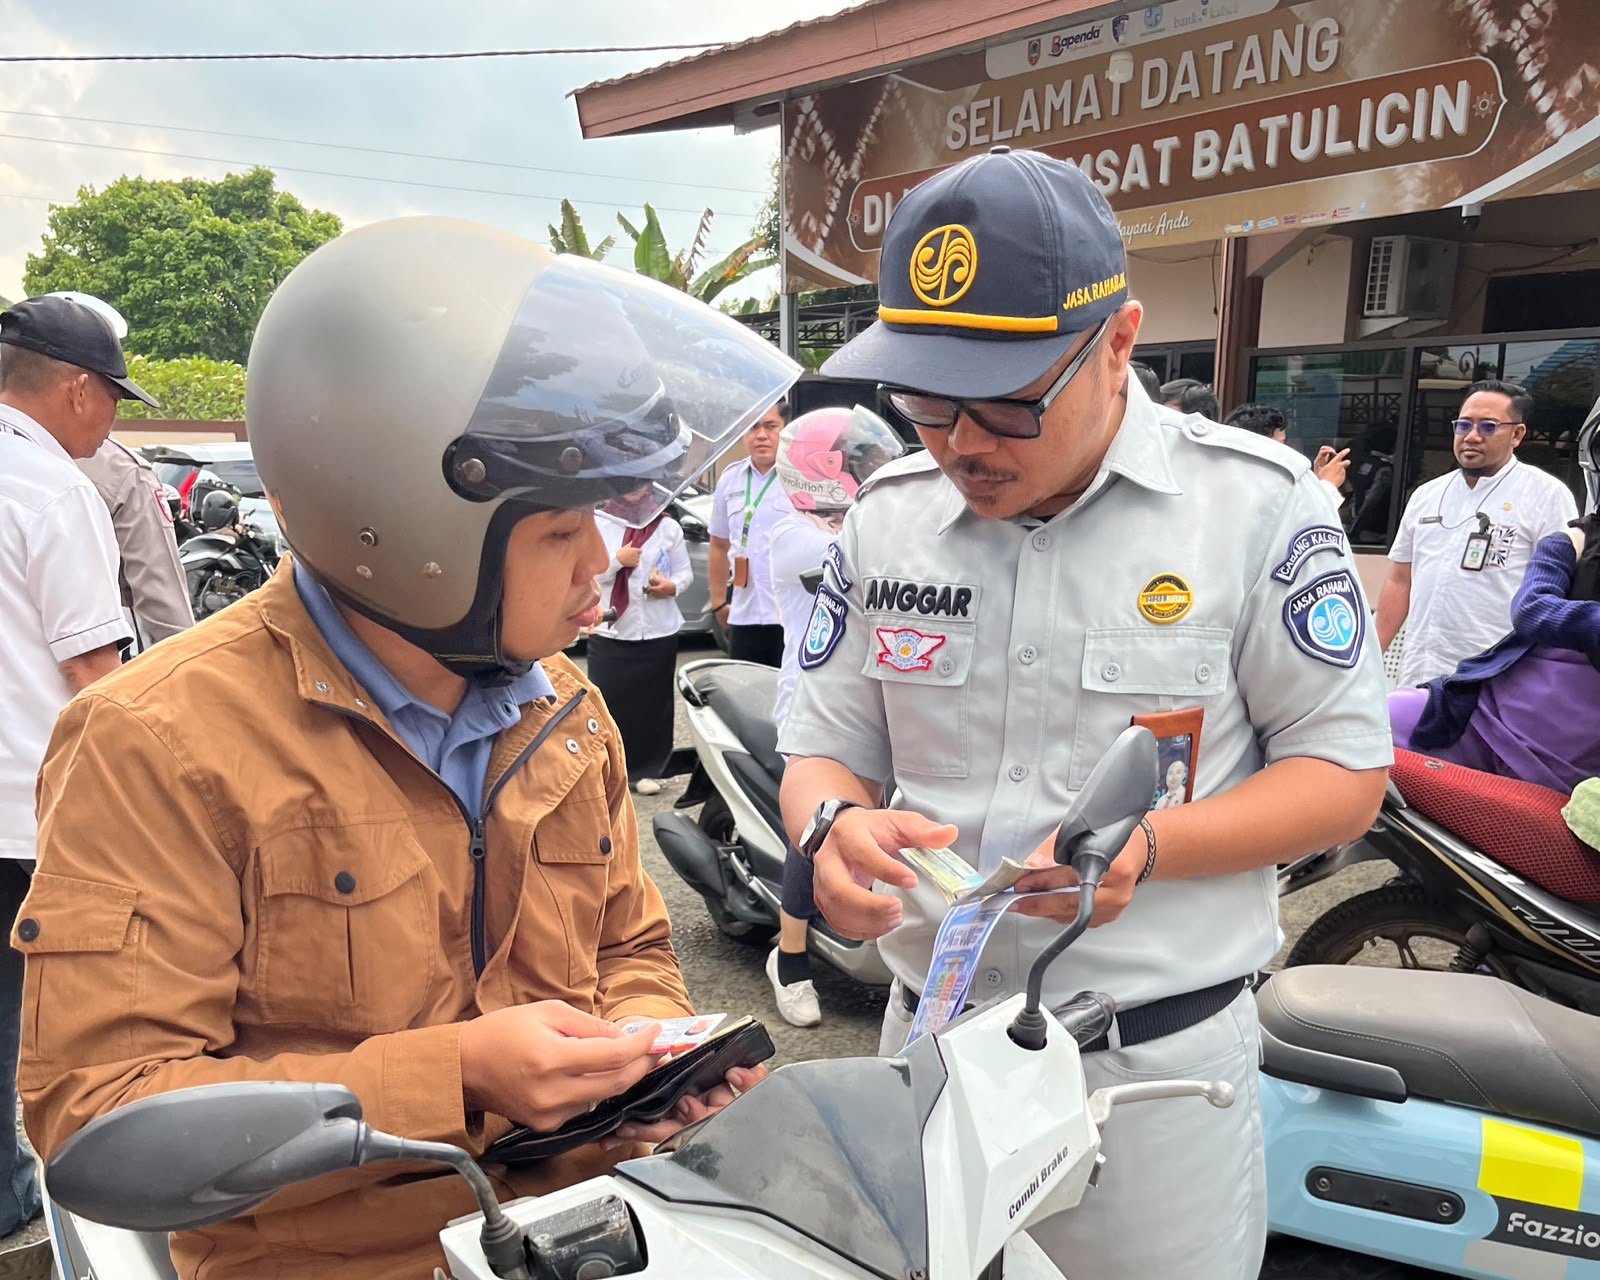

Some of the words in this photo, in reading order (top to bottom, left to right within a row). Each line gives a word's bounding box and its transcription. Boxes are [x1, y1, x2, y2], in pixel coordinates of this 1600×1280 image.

[1051, 25, 1100, 54] Bapenda
[1140, 16, 1342, 111] DATANG
[1192, 80, 1471, 181] BATULICIN
[1155, 210, 1192, 236] Anda
[1063, 286, 1092, 310] JASA
[1281, 538, 1310, 575] CABANG
[1311, 531, 1340, 545] KALSEL
[865, 579, 972, 617] ANGGAR
[1292, 595, 1316, 614] JASA
[1009, 1175, 1040, 1220] Combi
[1041, 1145, 1069, 1183] Brake
[1507, 1212, 1600, 1248] Fazzio
